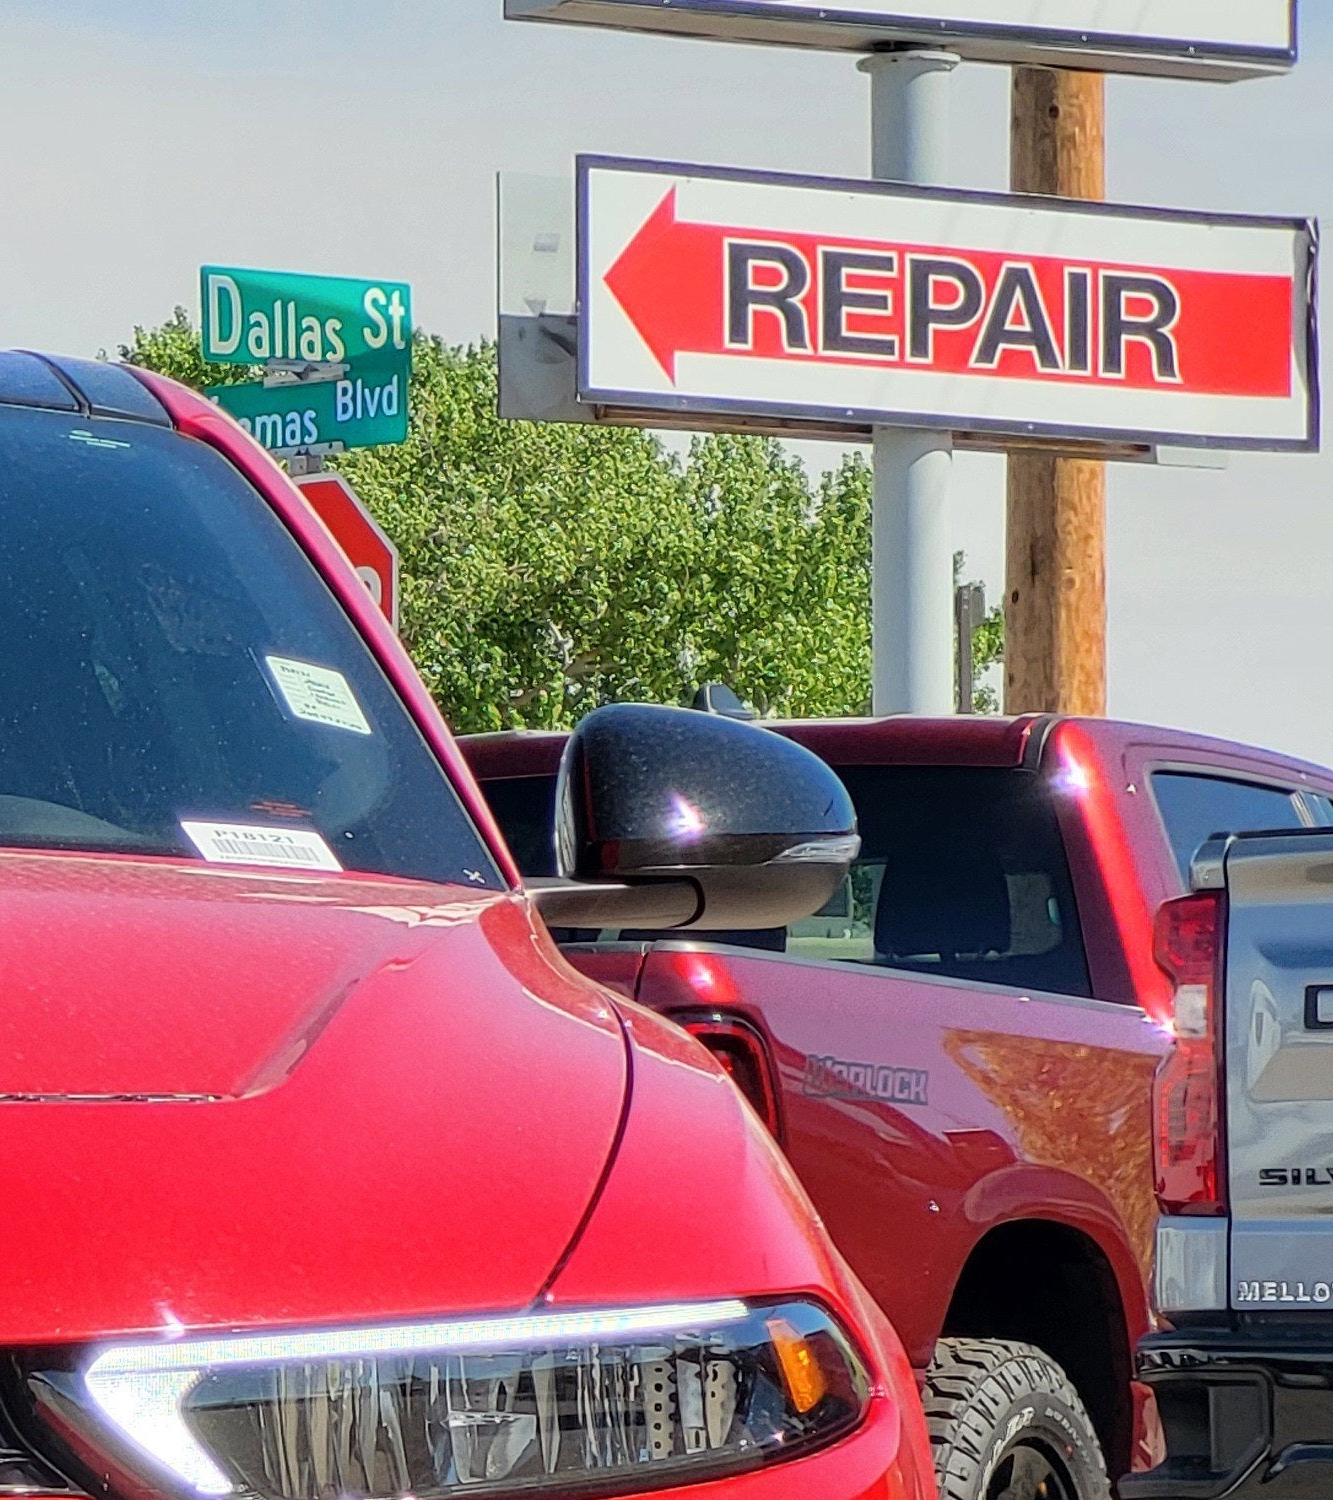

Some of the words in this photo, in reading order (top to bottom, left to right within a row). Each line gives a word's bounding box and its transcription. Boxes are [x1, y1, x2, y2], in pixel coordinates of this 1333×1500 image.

[207, 274, 346, 363] Dallas
[363, 287, 406, 350] St
[722, 236, 1183, 384] REPAIR
[210, 395, 318, 450] mas
[335, 373, 399, 423] Blvd
[1237, 1281, 1333, 1302] MELLO
